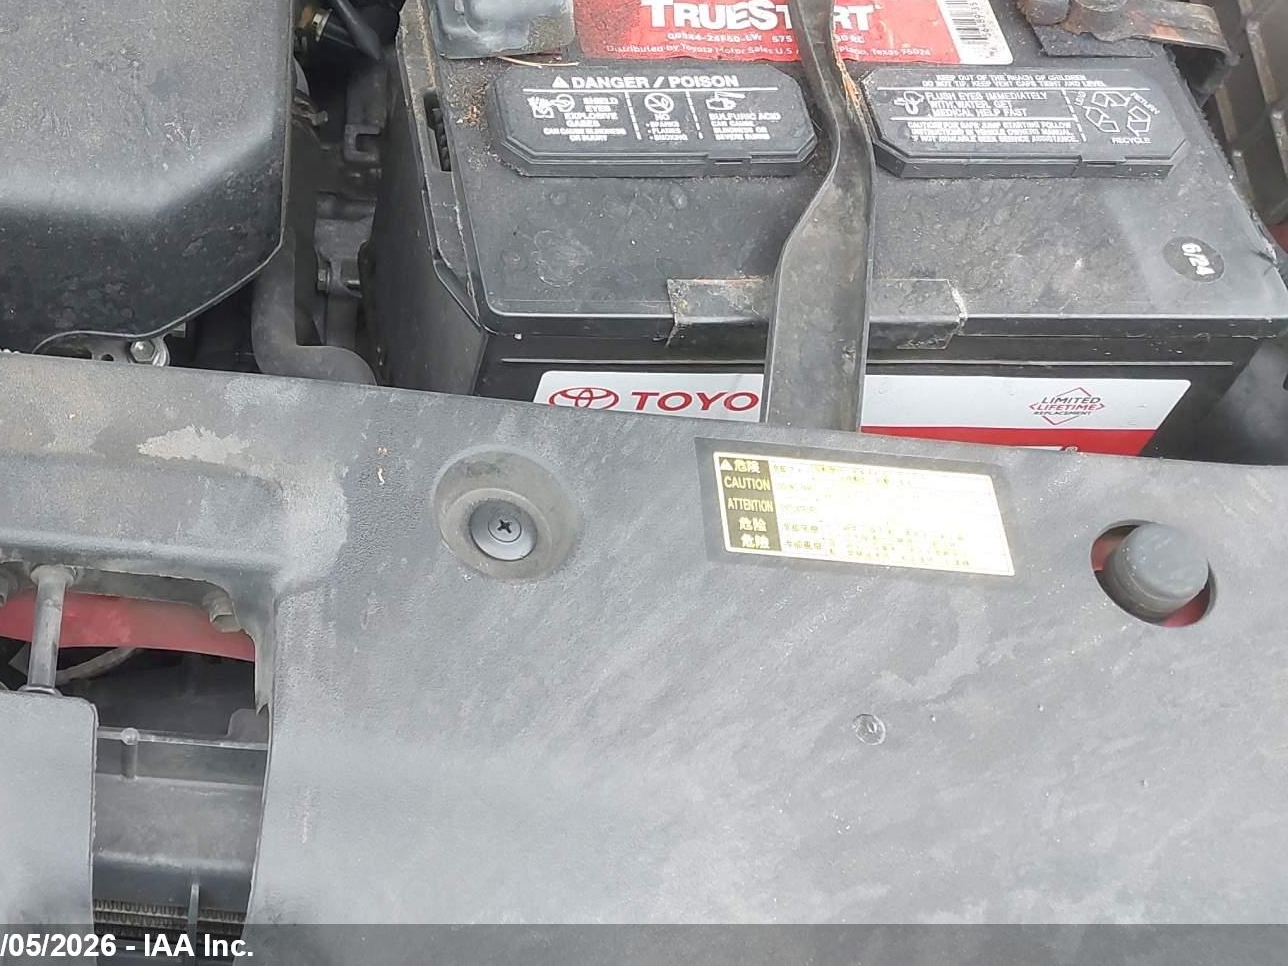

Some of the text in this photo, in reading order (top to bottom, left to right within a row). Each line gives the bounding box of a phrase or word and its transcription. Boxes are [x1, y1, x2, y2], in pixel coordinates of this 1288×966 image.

[771, 35, 793, 43] 575
[606, 45, 662, 53] Distributed
[665, 44, 679, 53] by
[680, 42, 713, 54] Toyota
[715, 46, 745, 54] Motor
[747, 45, 773, 54] Sales
[871, 48, 900, 56] Texas
[571, 75, 740, 89] DANGER / POISON
[924, 91, 1048, 101] FLUSH EYES IMMEDIATELY
[929, 100, 954, 109] WITH
[993, 100, 1013, 109] GET
[653, 113, 671, 121] NO
[931, 108, 1028, 117] MEDICAL HELP FAST
[1111, 136, 1152, 144] RECYCLE
[1181, 242, 1215, 276] 6/24
[631, 391, 760, 412] TOYO
[1041, 396, 1102, 404] LIMITED
[723, 476, 771, 491] CAUTION
[727, 497, 774, 512] ATTENTION
